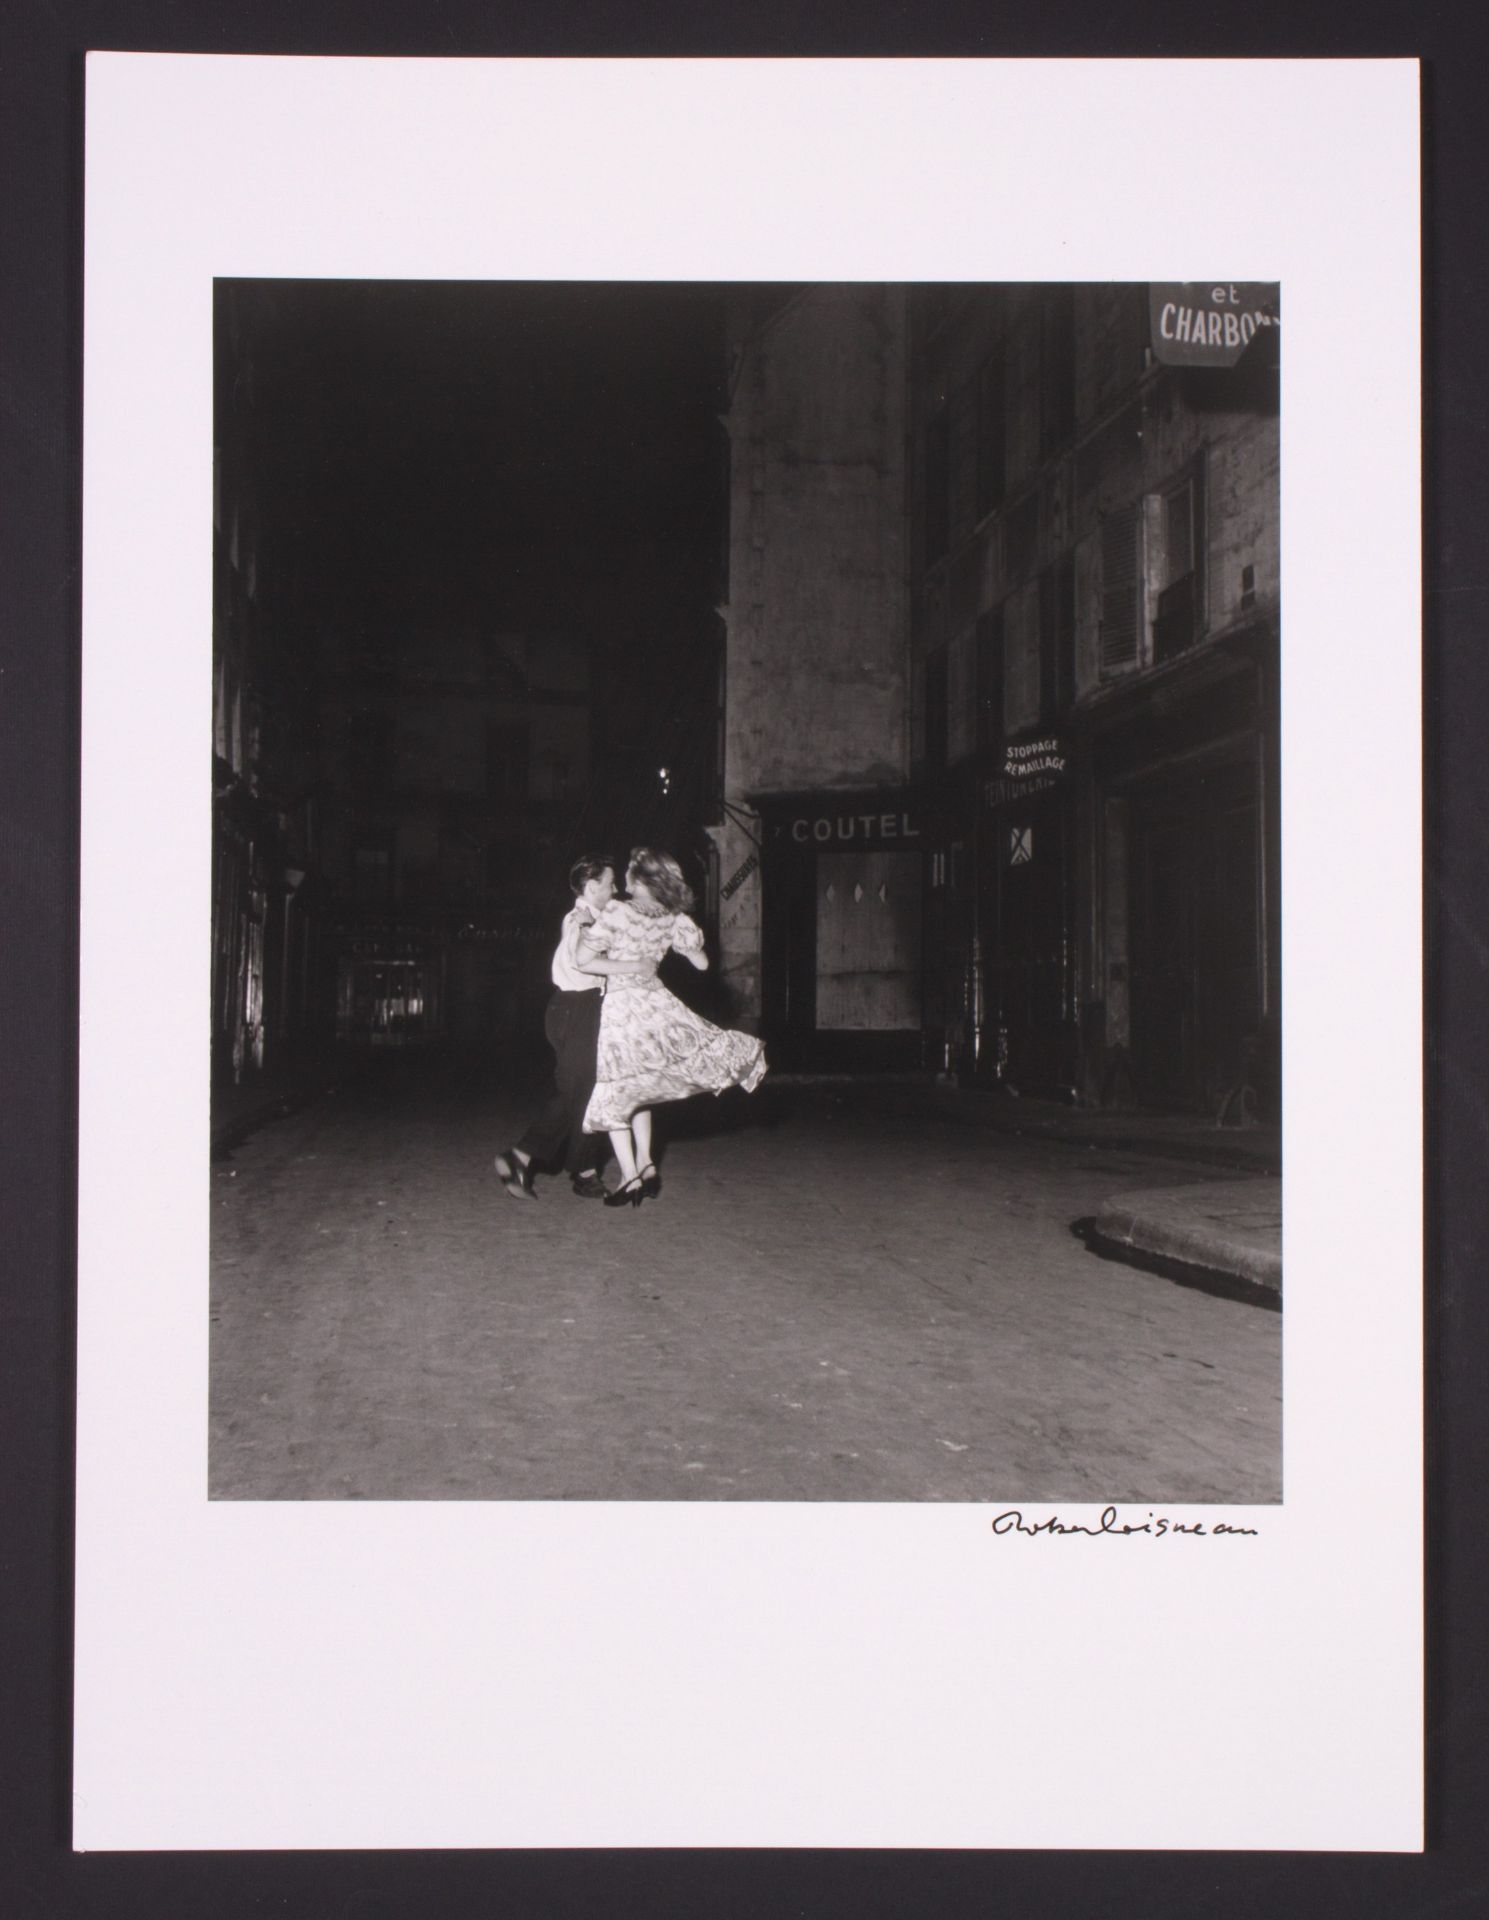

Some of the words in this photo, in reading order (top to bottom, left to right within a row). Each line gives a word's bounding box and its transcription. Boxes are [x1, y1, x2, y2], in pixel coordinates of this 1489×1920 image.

[1211, 284, 1240, 304] et
[1160, 303, 1280, 348] CHARBO
[1006, 739, 1058, 759] STOPPAGE
[1003, 755, 1066, 777] REMAILLAGE
[792, 813, 920, 843] COUTEL
